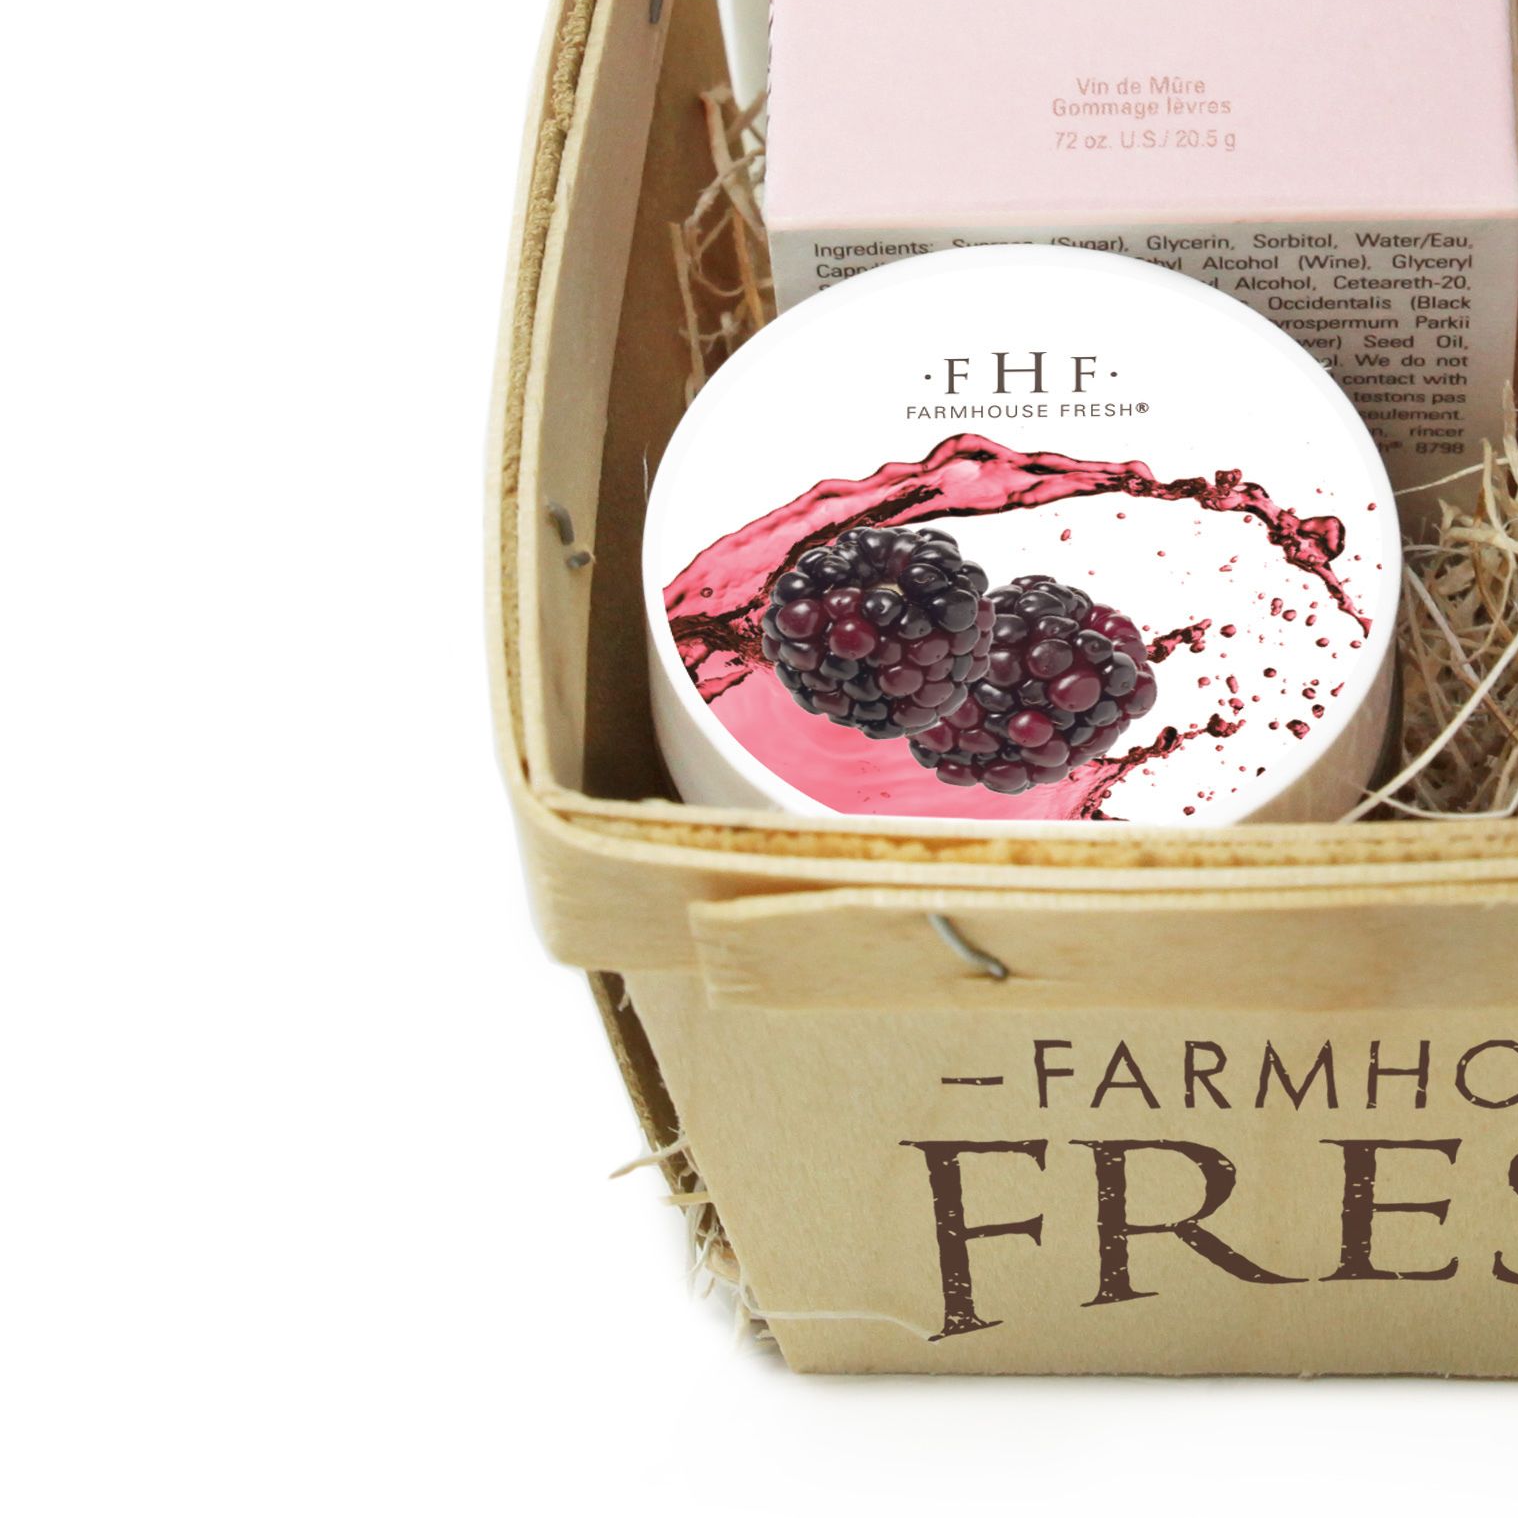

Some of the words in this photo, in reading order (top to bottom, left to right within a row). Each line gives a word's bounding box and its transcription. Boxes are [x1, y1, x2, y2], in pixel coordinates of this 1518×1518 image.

[1077, 77, 1110, 96] Vin
[1117, 77, 1142, 95] de
[1052, 98, 1160, 120] Gommage
[1225, 133, 1236, 152] g
[1202, 255, 1279, 271] Alcohol
[1391, 254, 1473, 272] Glyceryl
[1267, 296, 1392, 311] Occidentalis
[1410, 296, 1472, 312] (Black
[1415, 315, 1471, 330] Parkii
[1363, 335, 1415, 349] Seed
[1354, 354, 1391, 368] We
[1400, 355, 1427, 368] do
[1436, 356, 1469, 368] not
[1342, 373, 1416, 386] contact
[1422, 373, 1468, 386] with
[1431, 393, 1467, 406] pas
[906, 404, 1049, 420] FARMHOUSE
